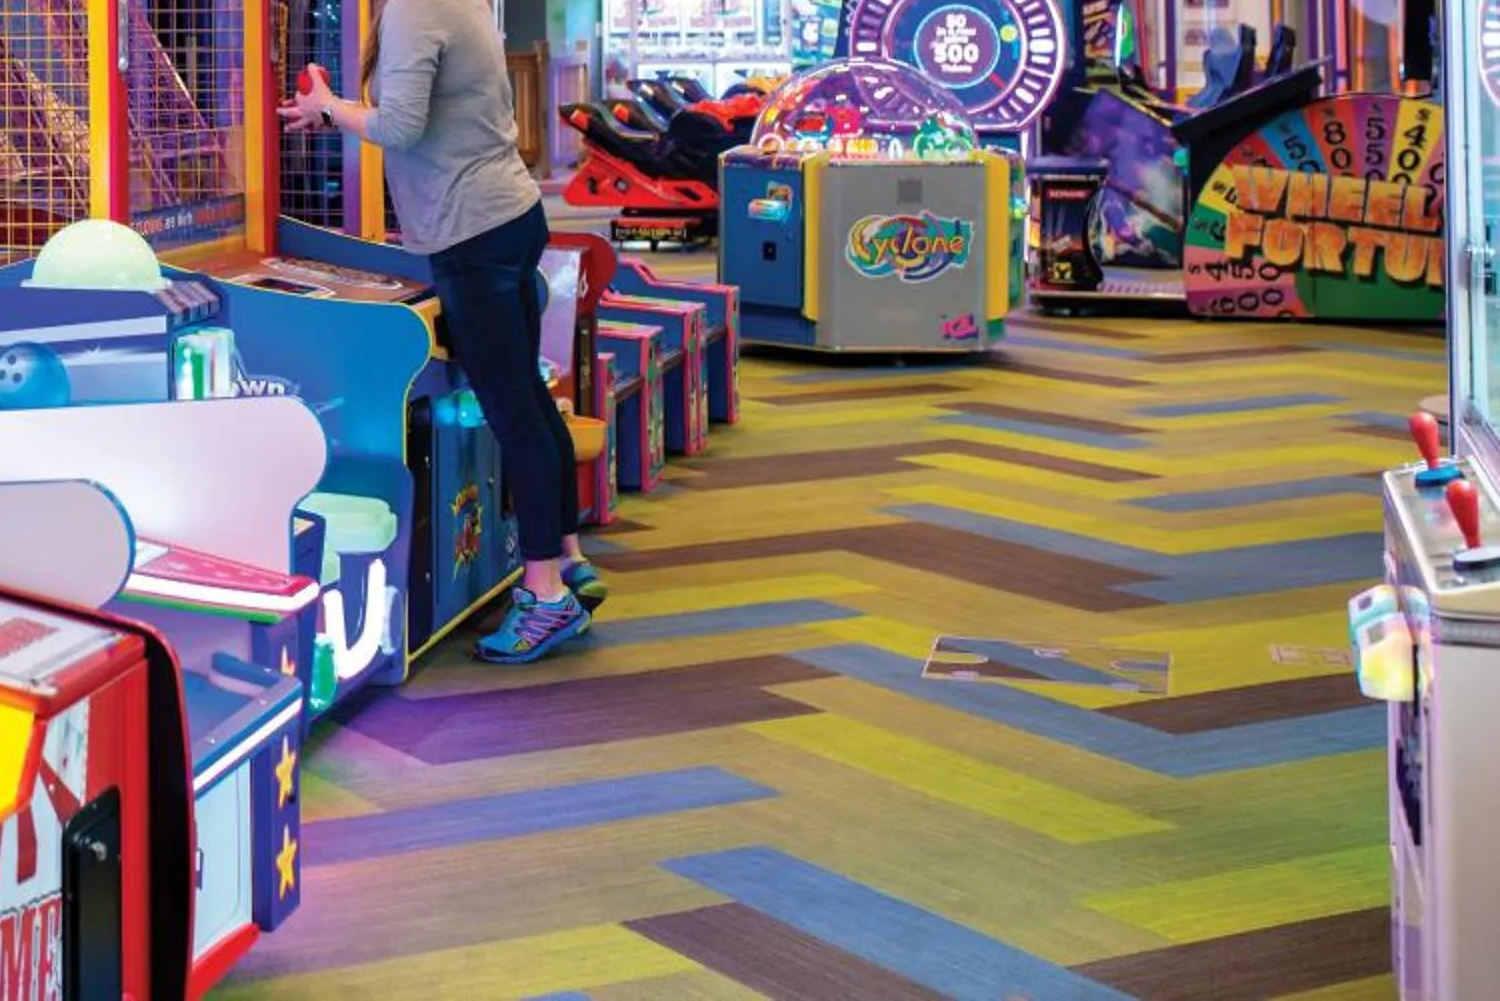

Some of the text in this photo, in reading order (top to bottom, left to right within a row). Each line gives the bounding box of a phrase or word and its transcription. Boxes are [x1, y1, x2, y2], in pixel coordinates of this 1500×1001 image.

[934, 43, 980, 63] 500
[1231, 164, 1440, 232] WHEEL
[850, 215, 966, 265] Cyclone
